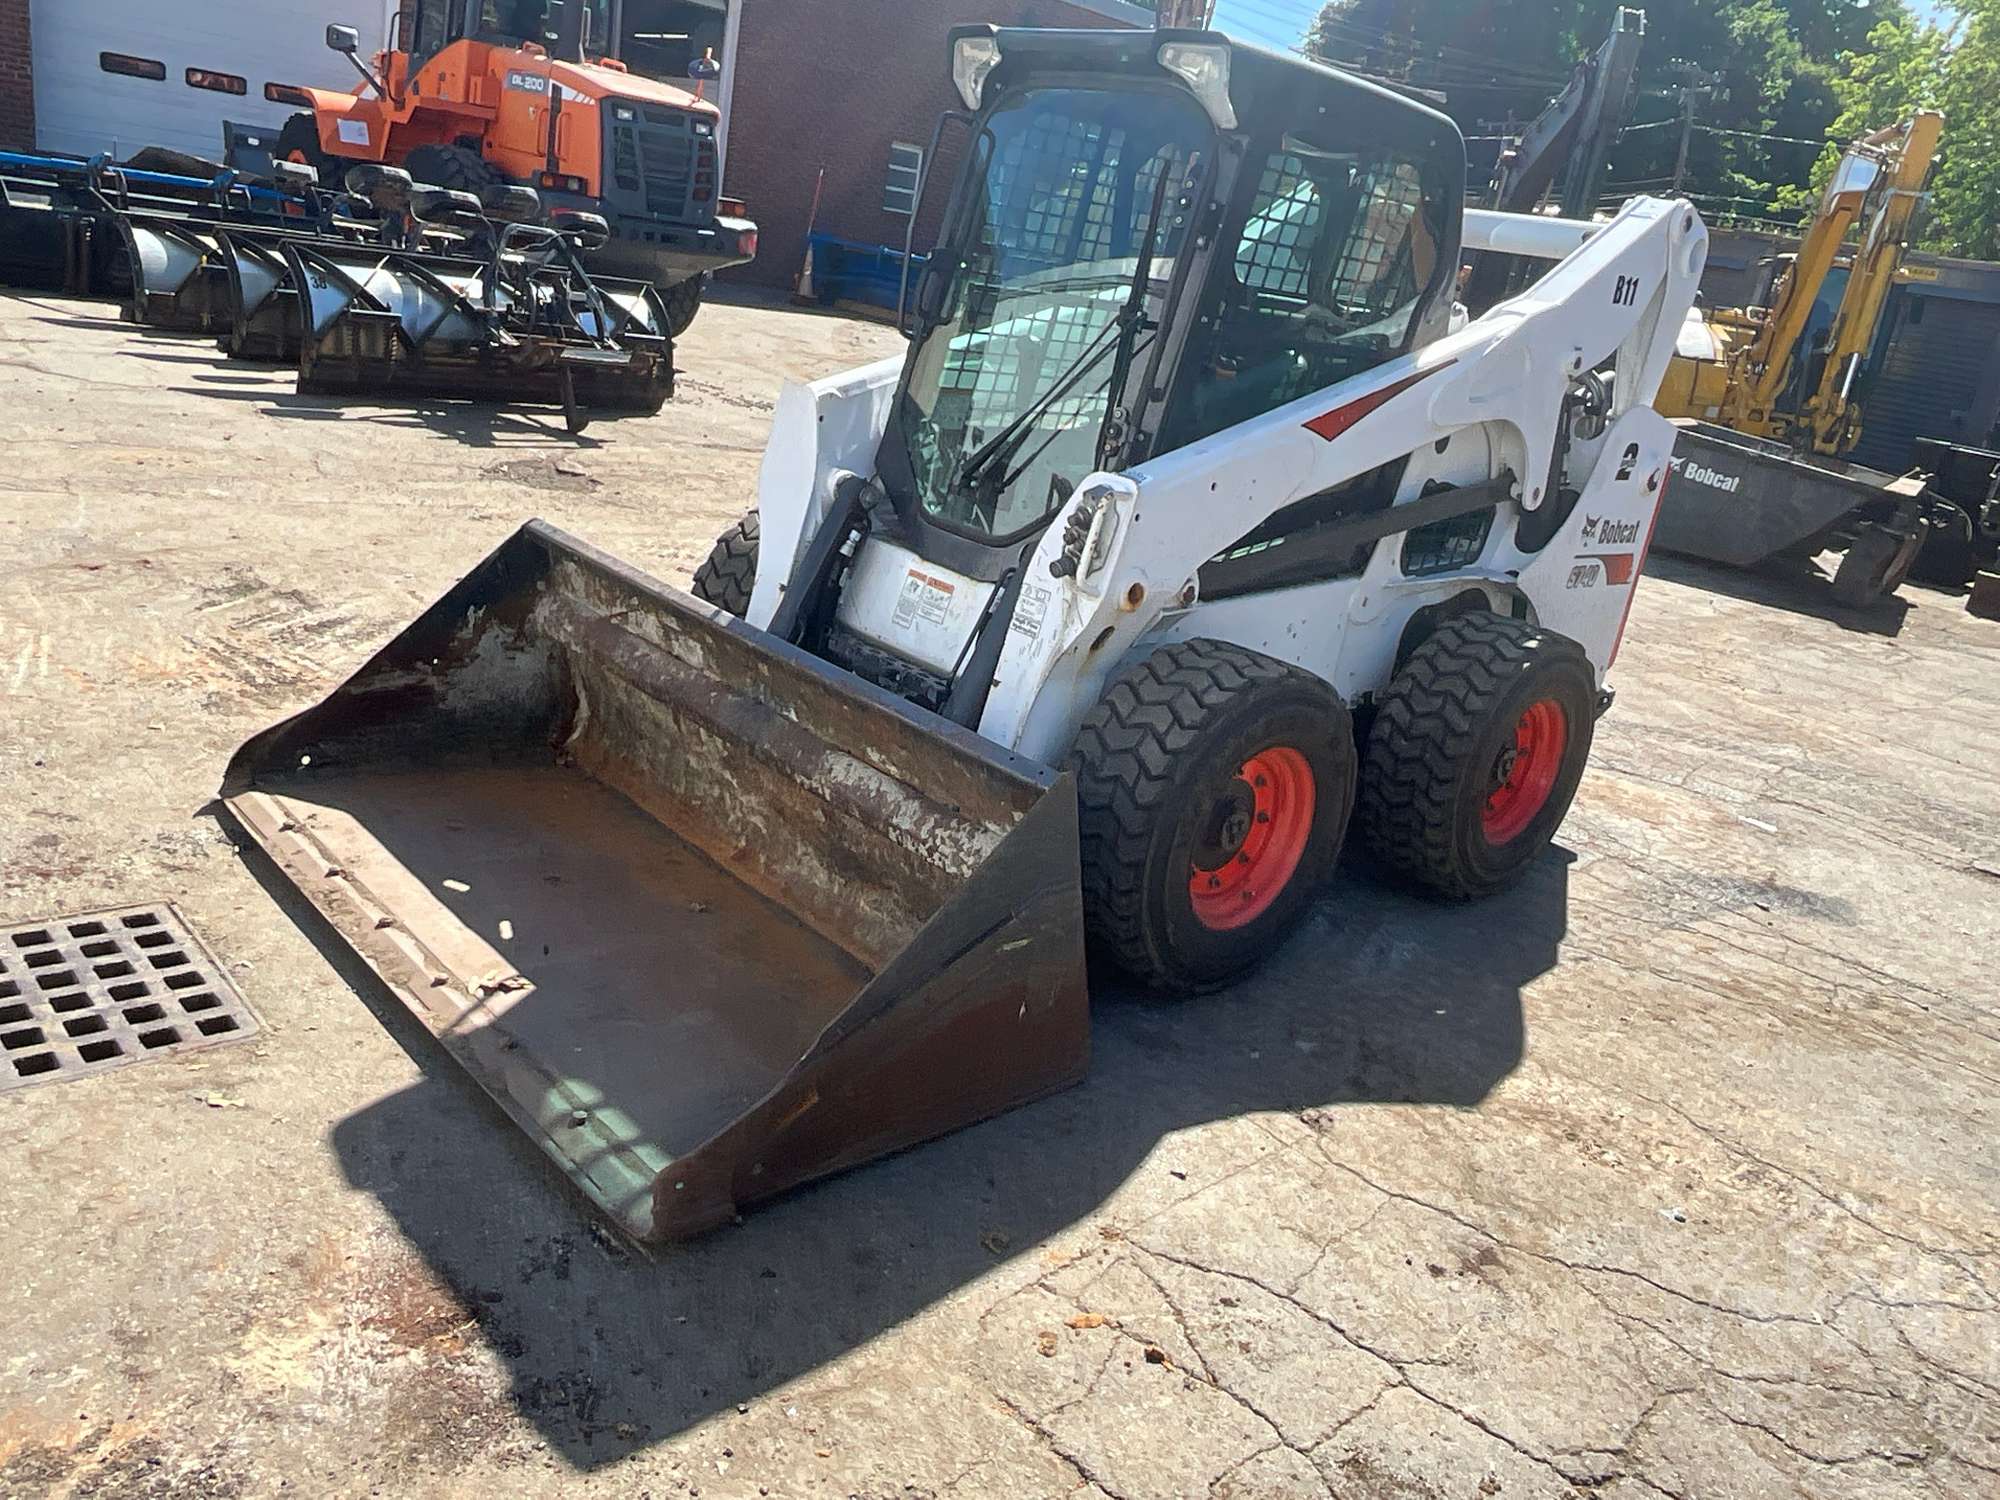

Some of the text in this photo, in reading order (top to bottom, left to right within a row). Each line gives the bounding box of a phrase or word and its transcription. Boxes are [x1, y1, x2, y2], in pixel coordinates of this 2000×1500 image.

[1612, 275, 1639, 306] B11
[1614, 442, 1639, 481] 2
[1684, 461, 1740, 493] Bobcat
[1598, 519, 1641, 545] Bobcat
